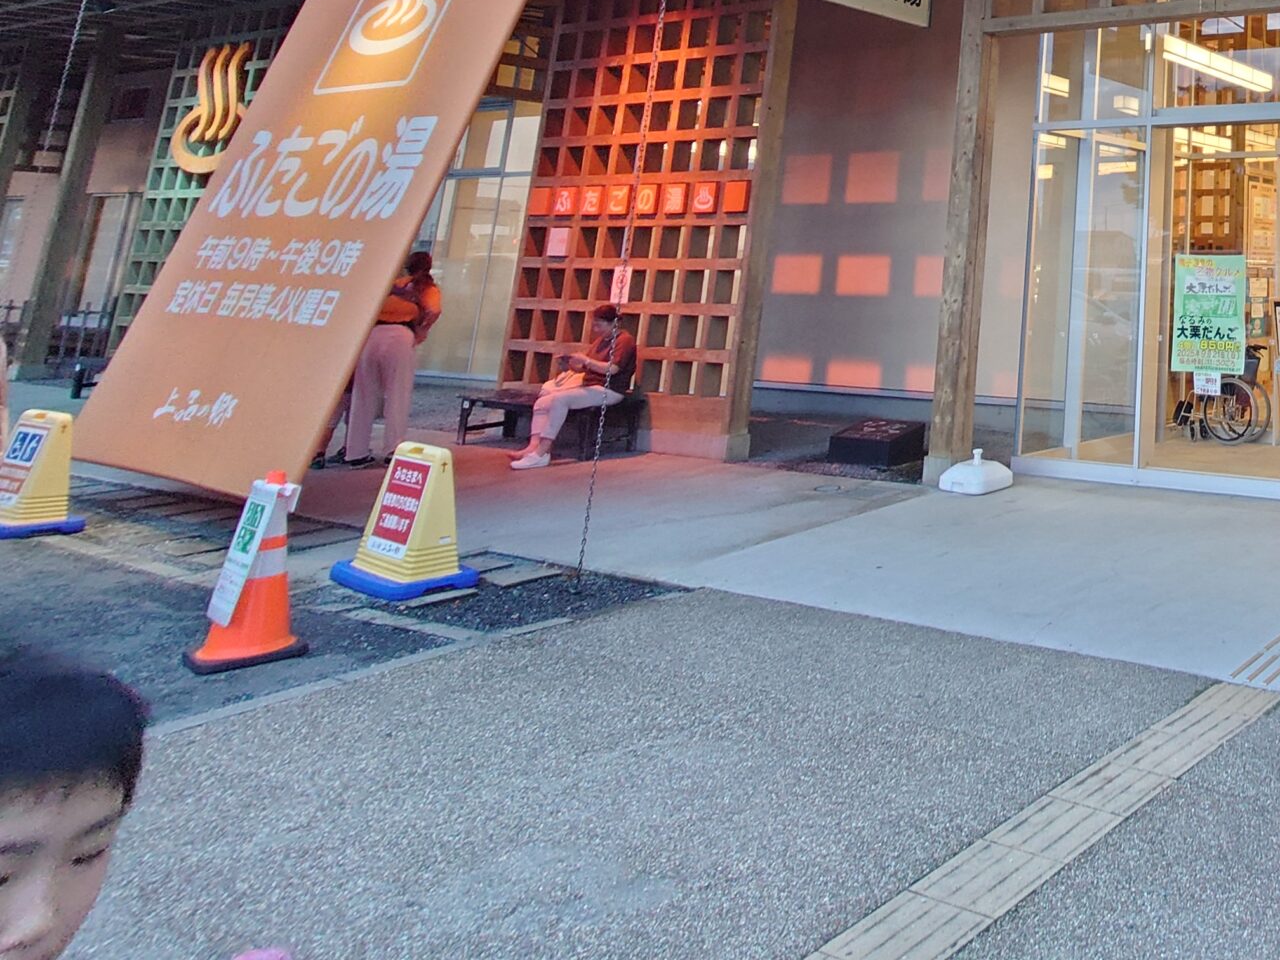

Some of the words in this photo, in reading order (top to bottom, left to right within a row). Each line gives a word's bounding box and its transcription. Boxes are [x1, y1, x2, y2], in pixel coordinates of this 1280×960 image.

[208, 115, 438, 221] ふたごの湯
[555, 187, 684, 214] ふたごの湯
[165, 279, 224, 315] 定休日
[216, 283, 340, 327] 毎月第4火曜日
[1177, 325, 1239, 340] 大栗だんご
